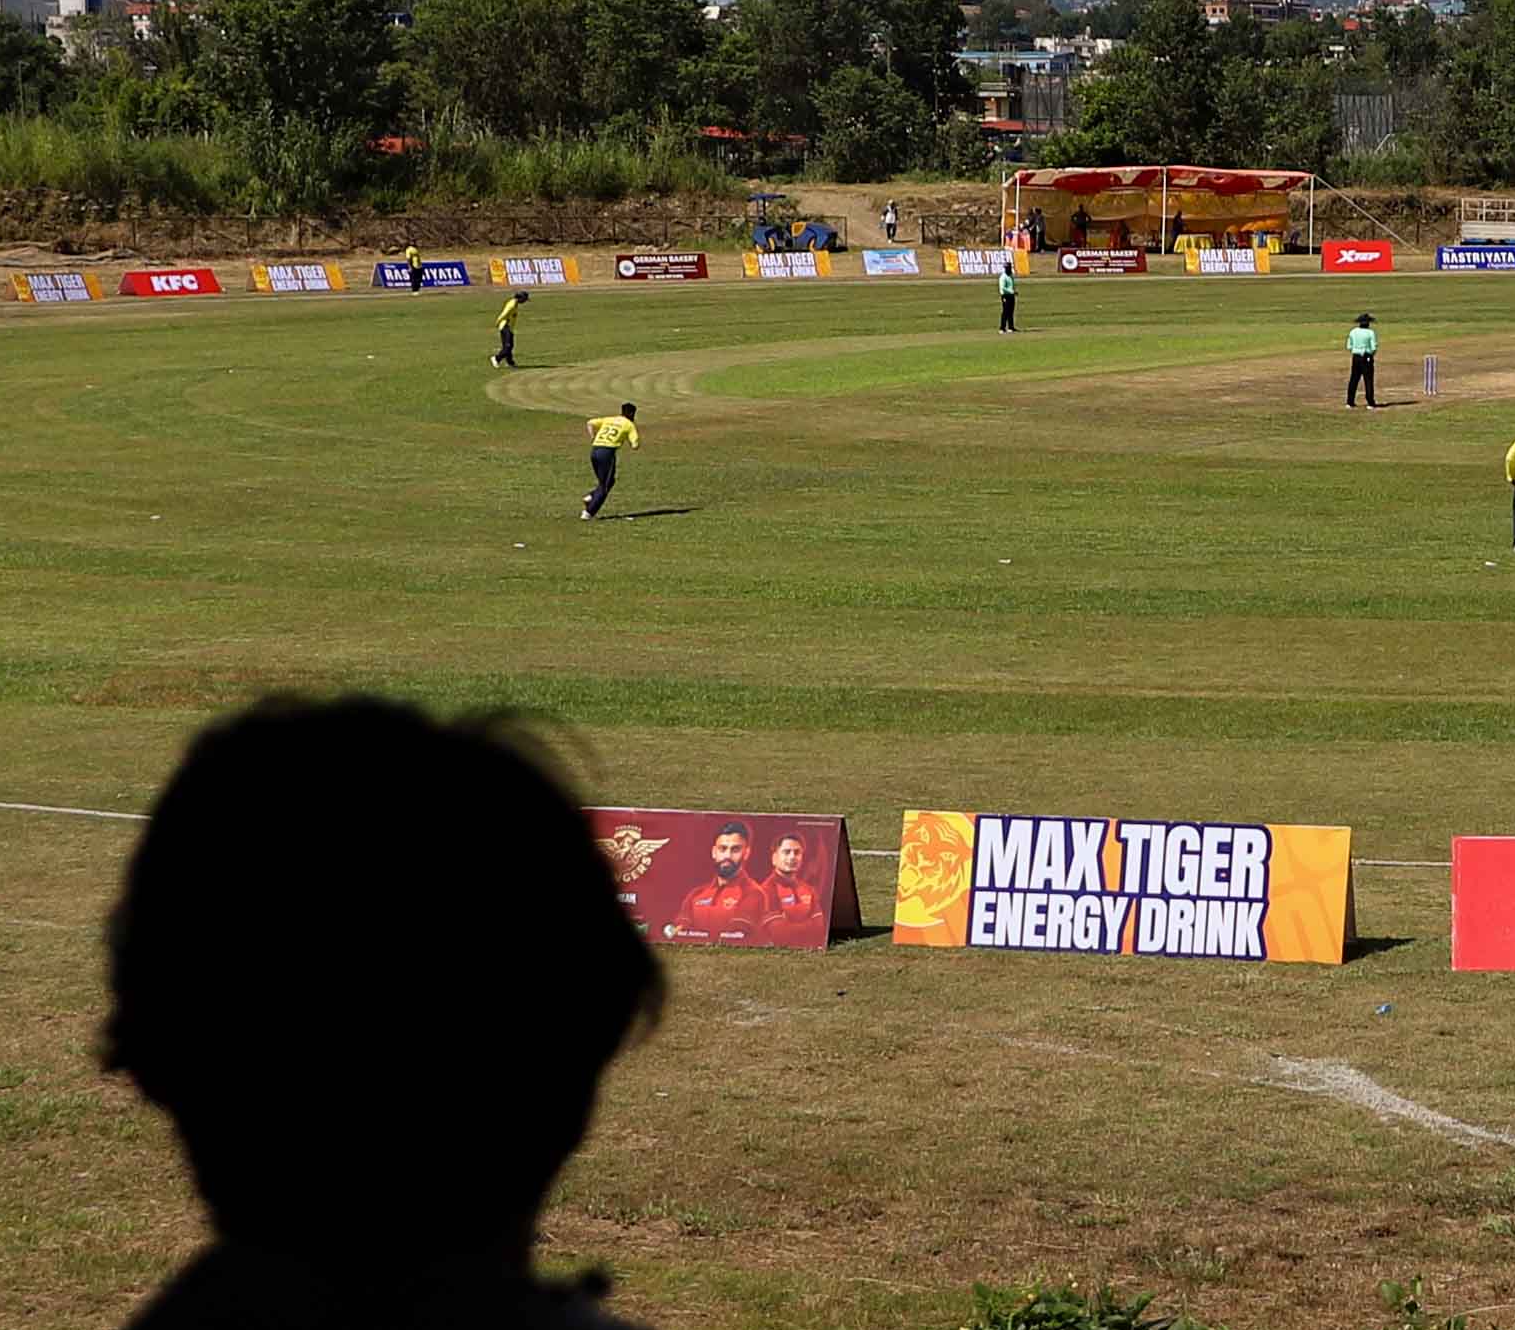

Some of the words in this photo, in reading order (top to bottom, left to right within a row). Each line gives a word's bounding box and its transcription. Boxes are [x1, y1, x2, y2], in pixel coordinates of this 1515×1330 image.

[758, 253, 784, 266] MAX
[786, 252, 814, 266] TIGER
[958, 251, 984, 263] MAX
[985, 250, 1014, 263] TIGER
[1200, 249, 1224, 262] MAX
[1226, 249, 1254, 262] TIGER
[1442, 252, 1515, 263] RASTRIYATA
[268, 264, 295, 280] MAX
[296, 264, 326, 279] TIGER
[385, 268, 462, 280] RASIYATA
[505, 259, 531, 274] MAX
[532, 258, 562, 274] TIGER
[28, 274, 54, 290] MAX
[56, 274, 86, 289] TIGER
[150, 274, 198, 292] KFC
[975, 818, 1105, 891] MAX
[1116, 823, 1267, 898] TIGER
[972, 891, 1129, 951] ENERGY
[1137, 897, 1263, 957] DRINK
